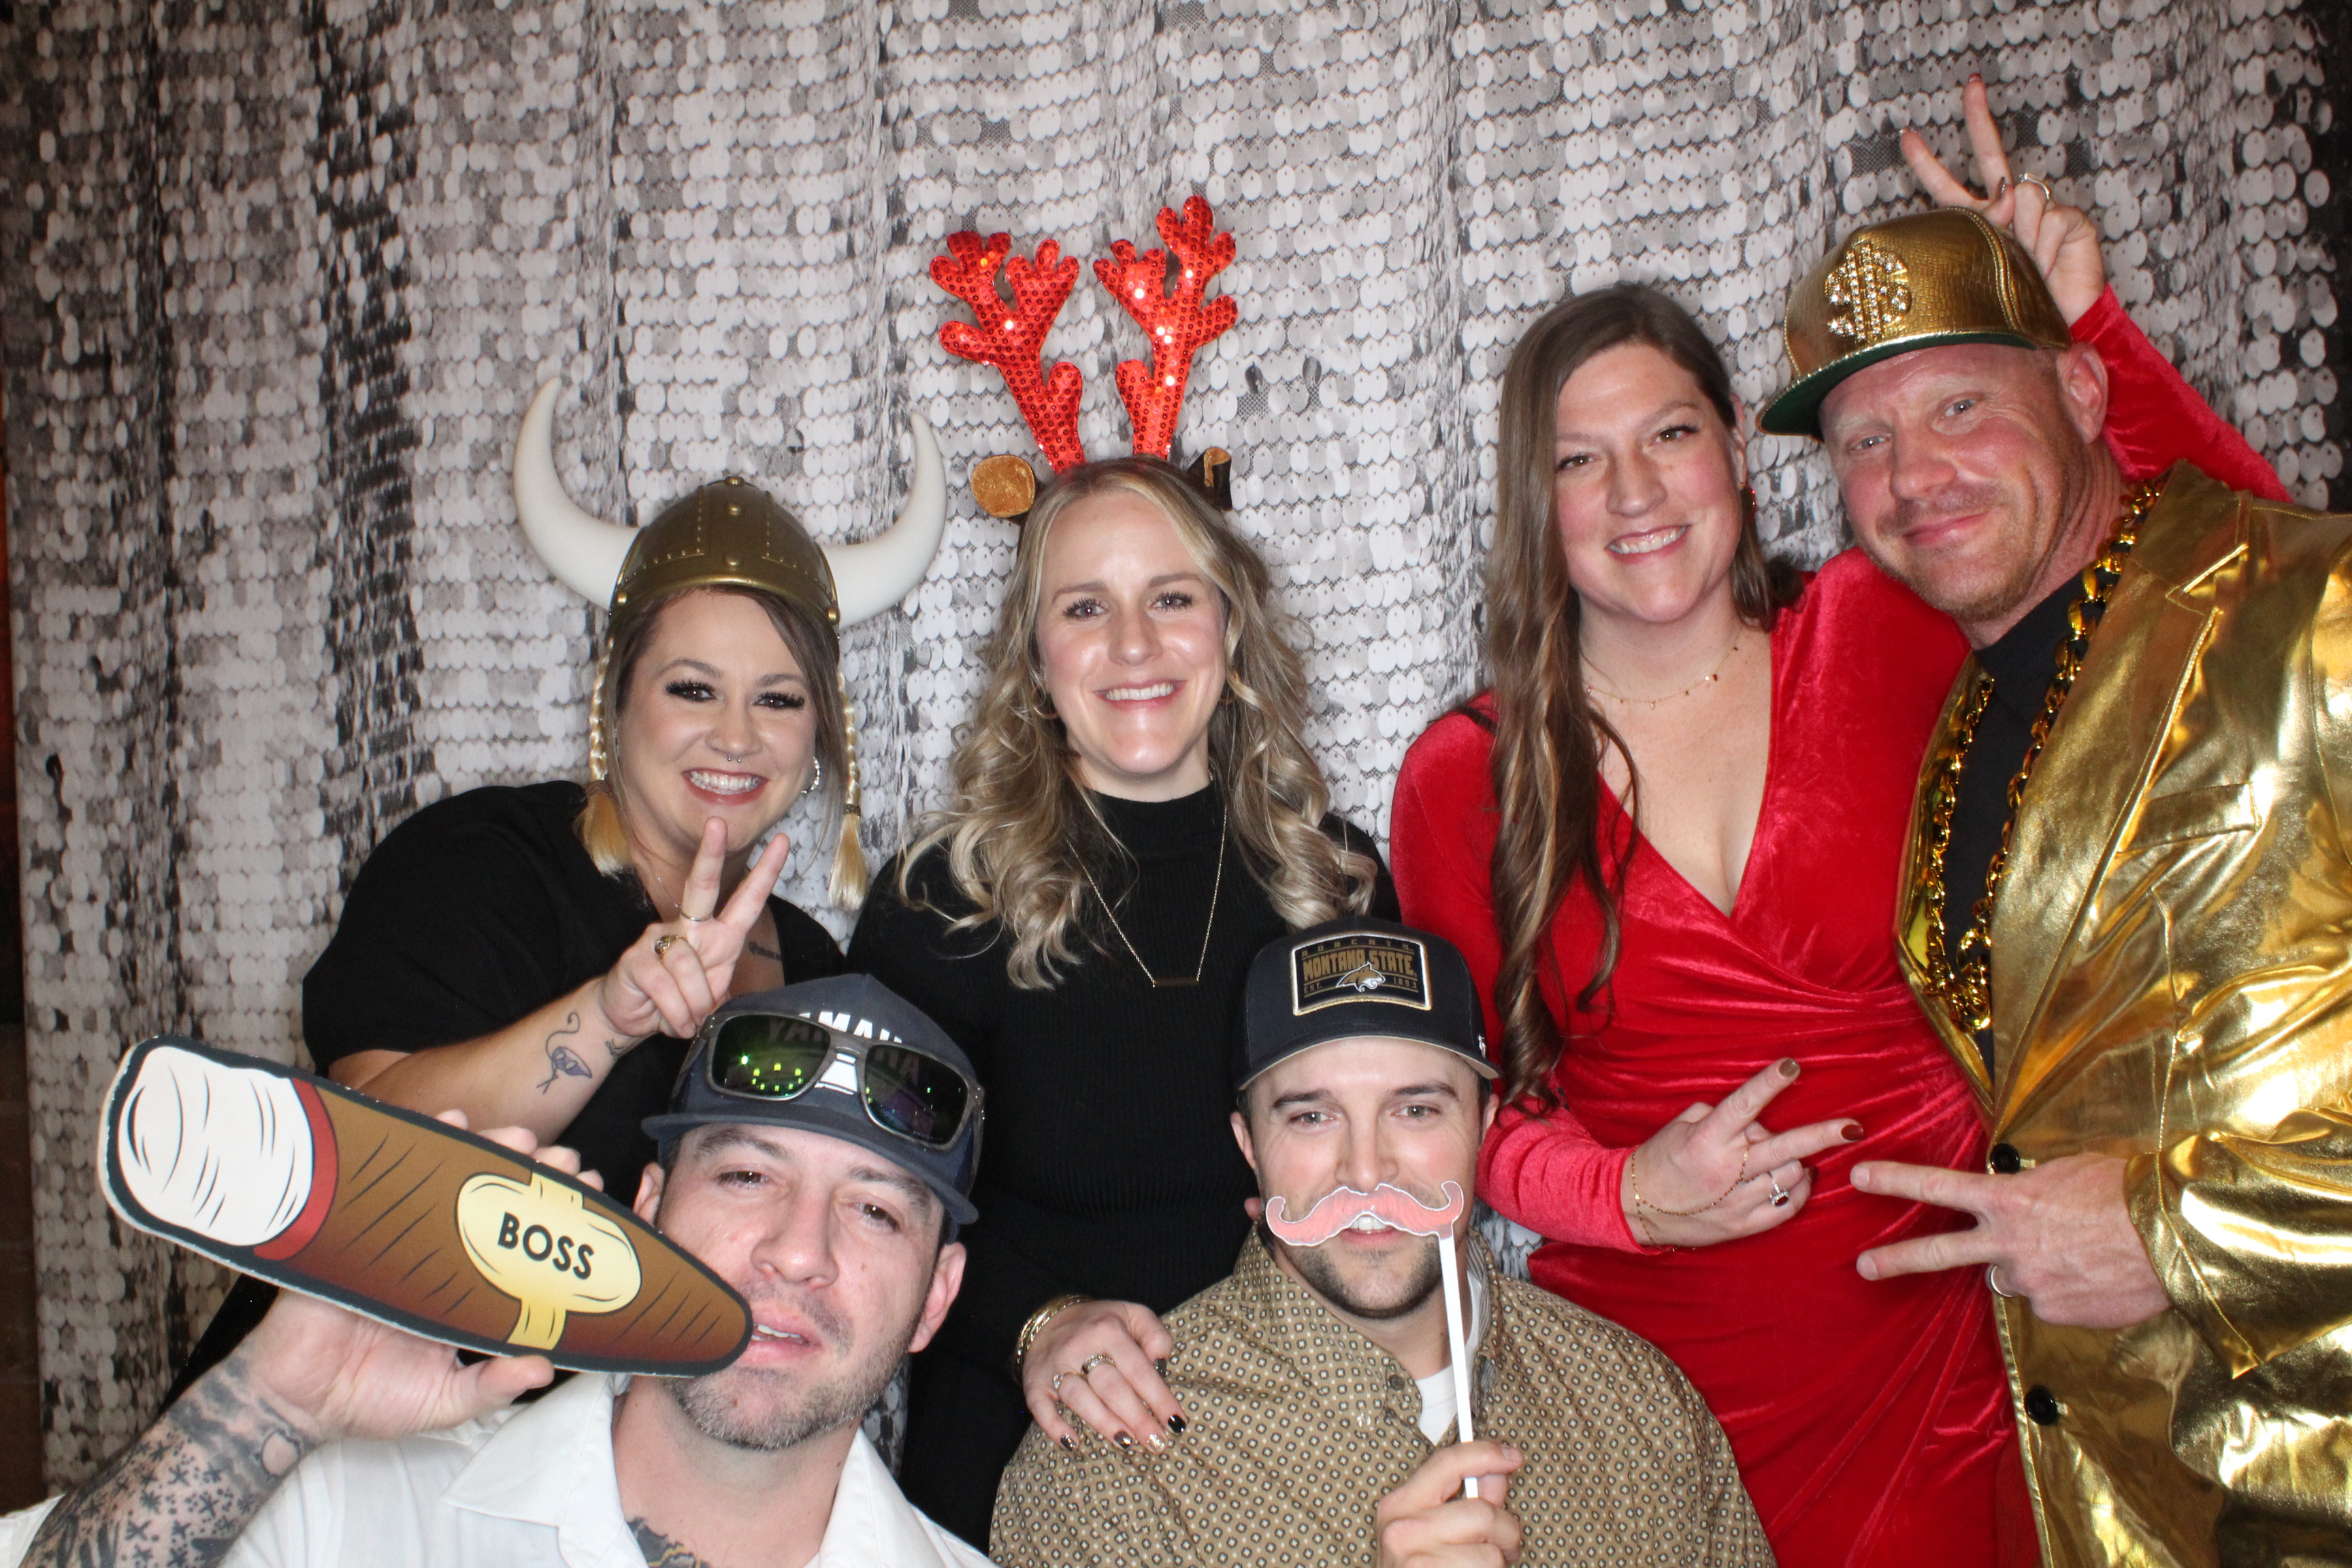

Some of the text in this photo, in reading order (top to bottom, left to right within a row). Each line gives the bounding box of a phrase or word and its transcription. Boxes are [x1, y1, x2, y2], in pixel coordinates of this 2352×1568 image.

[1303, 948, 1415, 981] MONTANA STATE
[1393, 977, 1417, 988] 1893
[497, 1211, 594, 1279] BOSS
